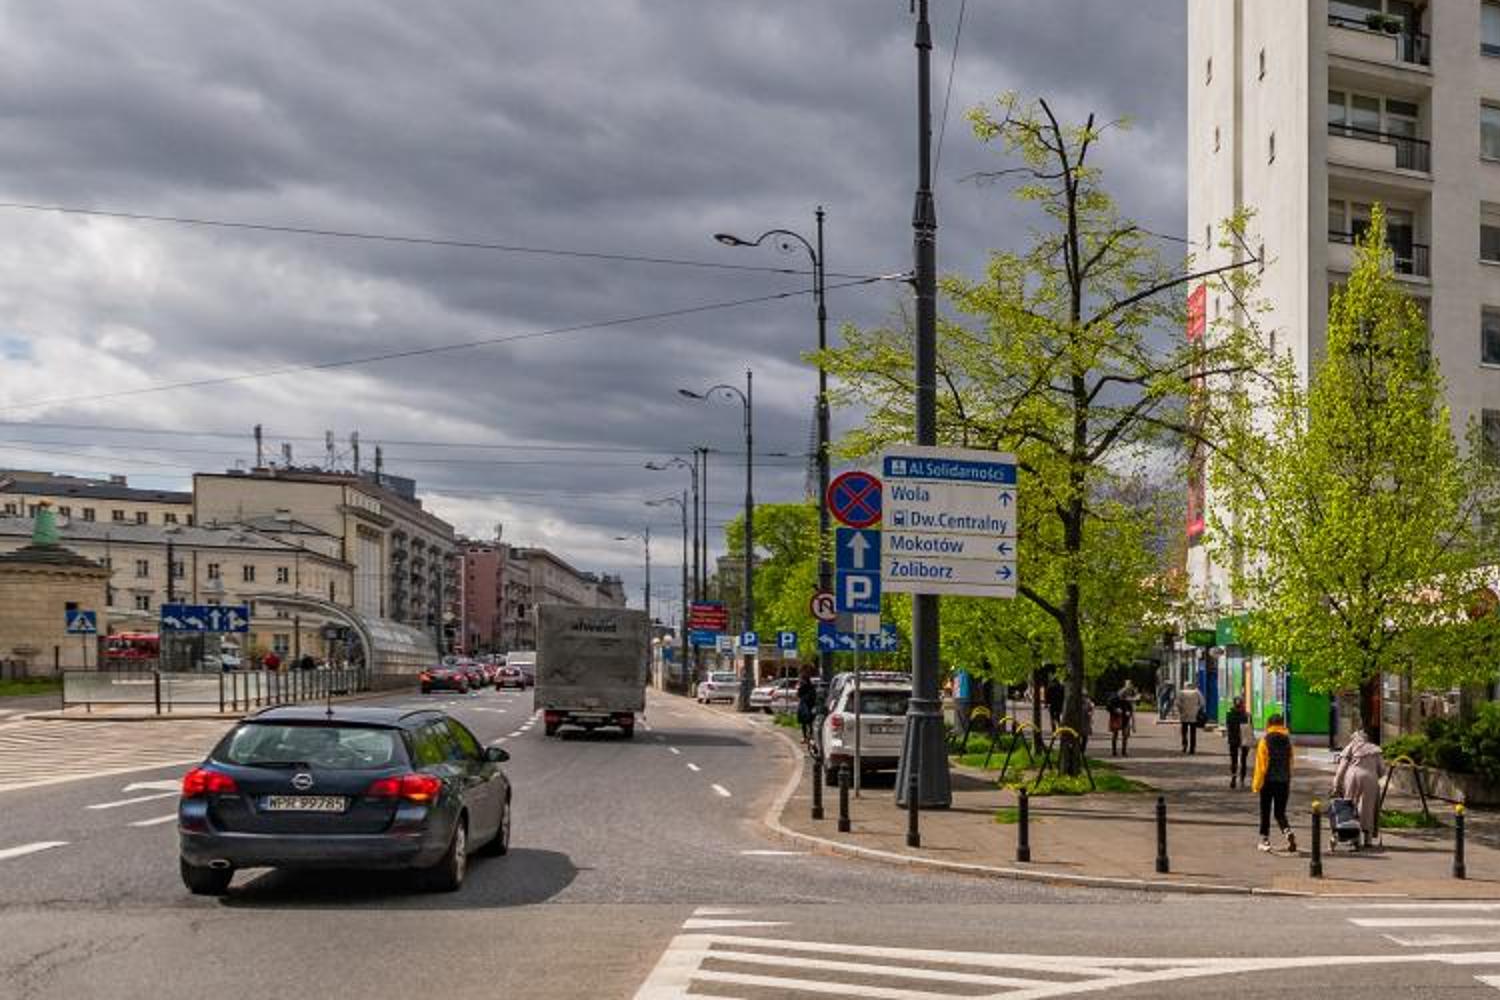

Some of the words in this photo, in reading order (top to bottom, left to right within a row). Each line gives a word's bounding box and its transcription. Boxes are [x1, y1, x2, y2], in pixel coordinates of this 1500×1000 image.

[891, 486, 929, 502] Wola
[890, 535, 965, 553] Mokotów
[890, 557, 953, 579] Żoliborz
[846, 575, 872, 608] P
[744, 633, 755, 645] P
[781, 633, 793, 646] P
